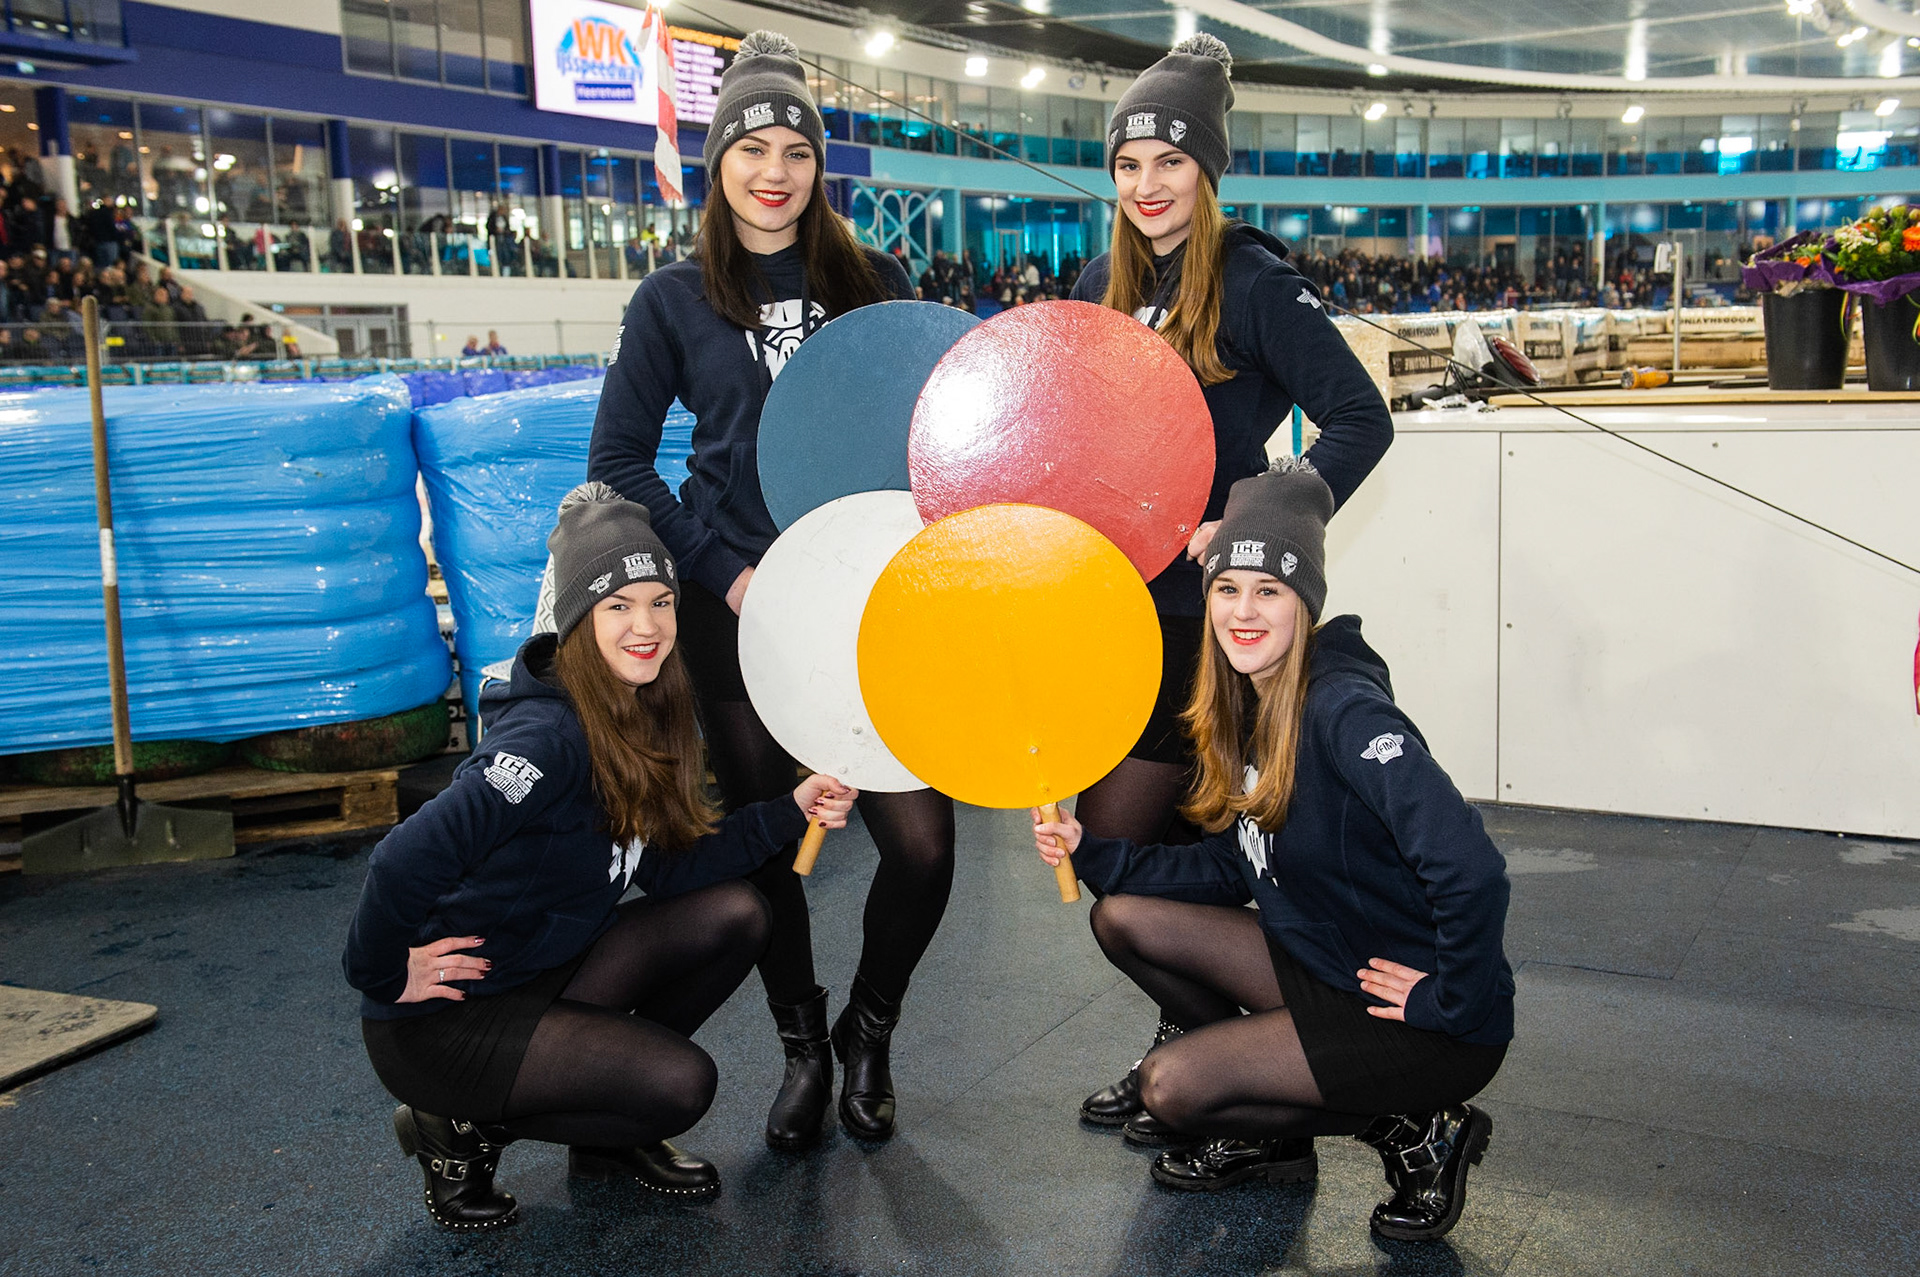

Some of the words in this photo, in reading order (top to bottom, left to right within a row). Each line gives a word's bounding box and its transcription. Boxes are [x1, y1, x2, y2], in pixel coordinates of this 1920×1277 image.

[573, 19, 628, 65] WK
[743, 103, 772, 120] ICE
[1127, 114, 1157, 127] ICE
[1232, 543, 1265, 553] ICE
[623, 555, 654, 568] ICE
[1378, 741, 1396, 753] FIM
[494, 752, 542, 788] ICE
[484, 767, 526, 804] GLADIATORS
